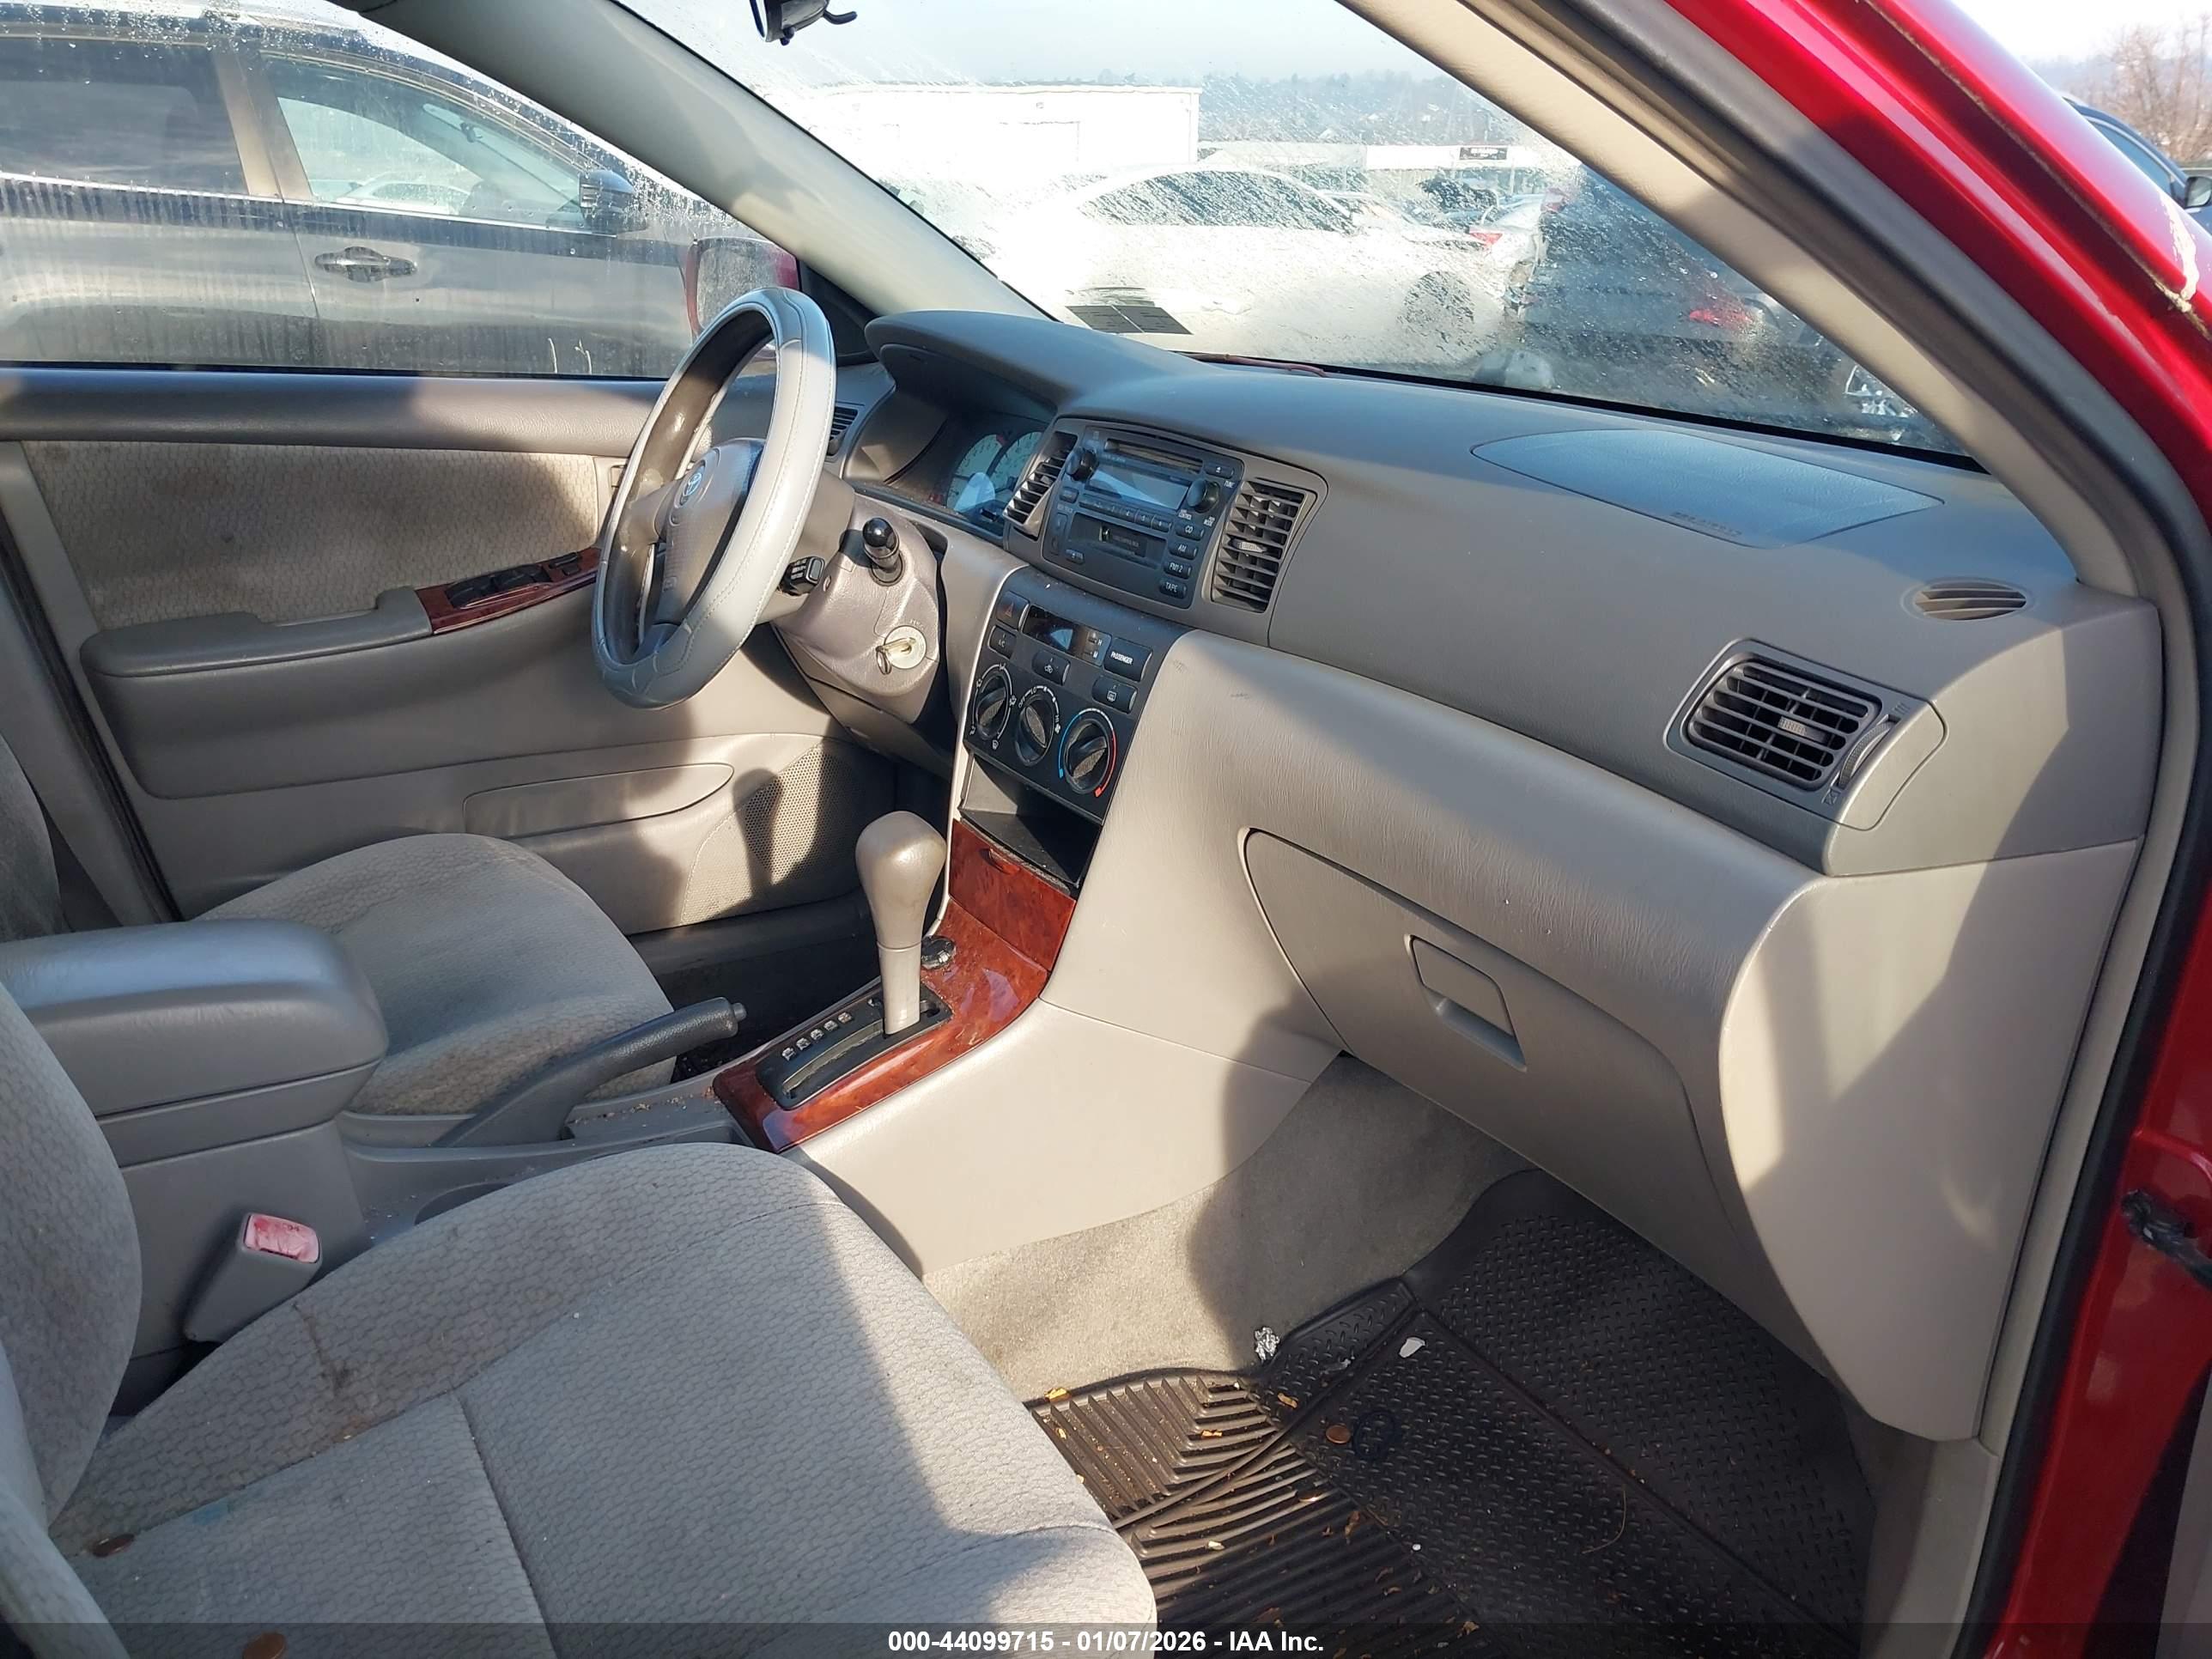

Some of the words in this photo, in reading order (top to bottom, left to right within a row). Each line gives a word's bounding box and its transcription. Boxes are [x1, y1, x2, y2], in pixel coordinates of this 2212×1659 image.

[1185, 526, 1194, 534] CD
[1178, 544, 1187, 552] AM
[1166, 581, 1178, 592] TAPE
[1110, 651, 1133, 665] PASSENGER
